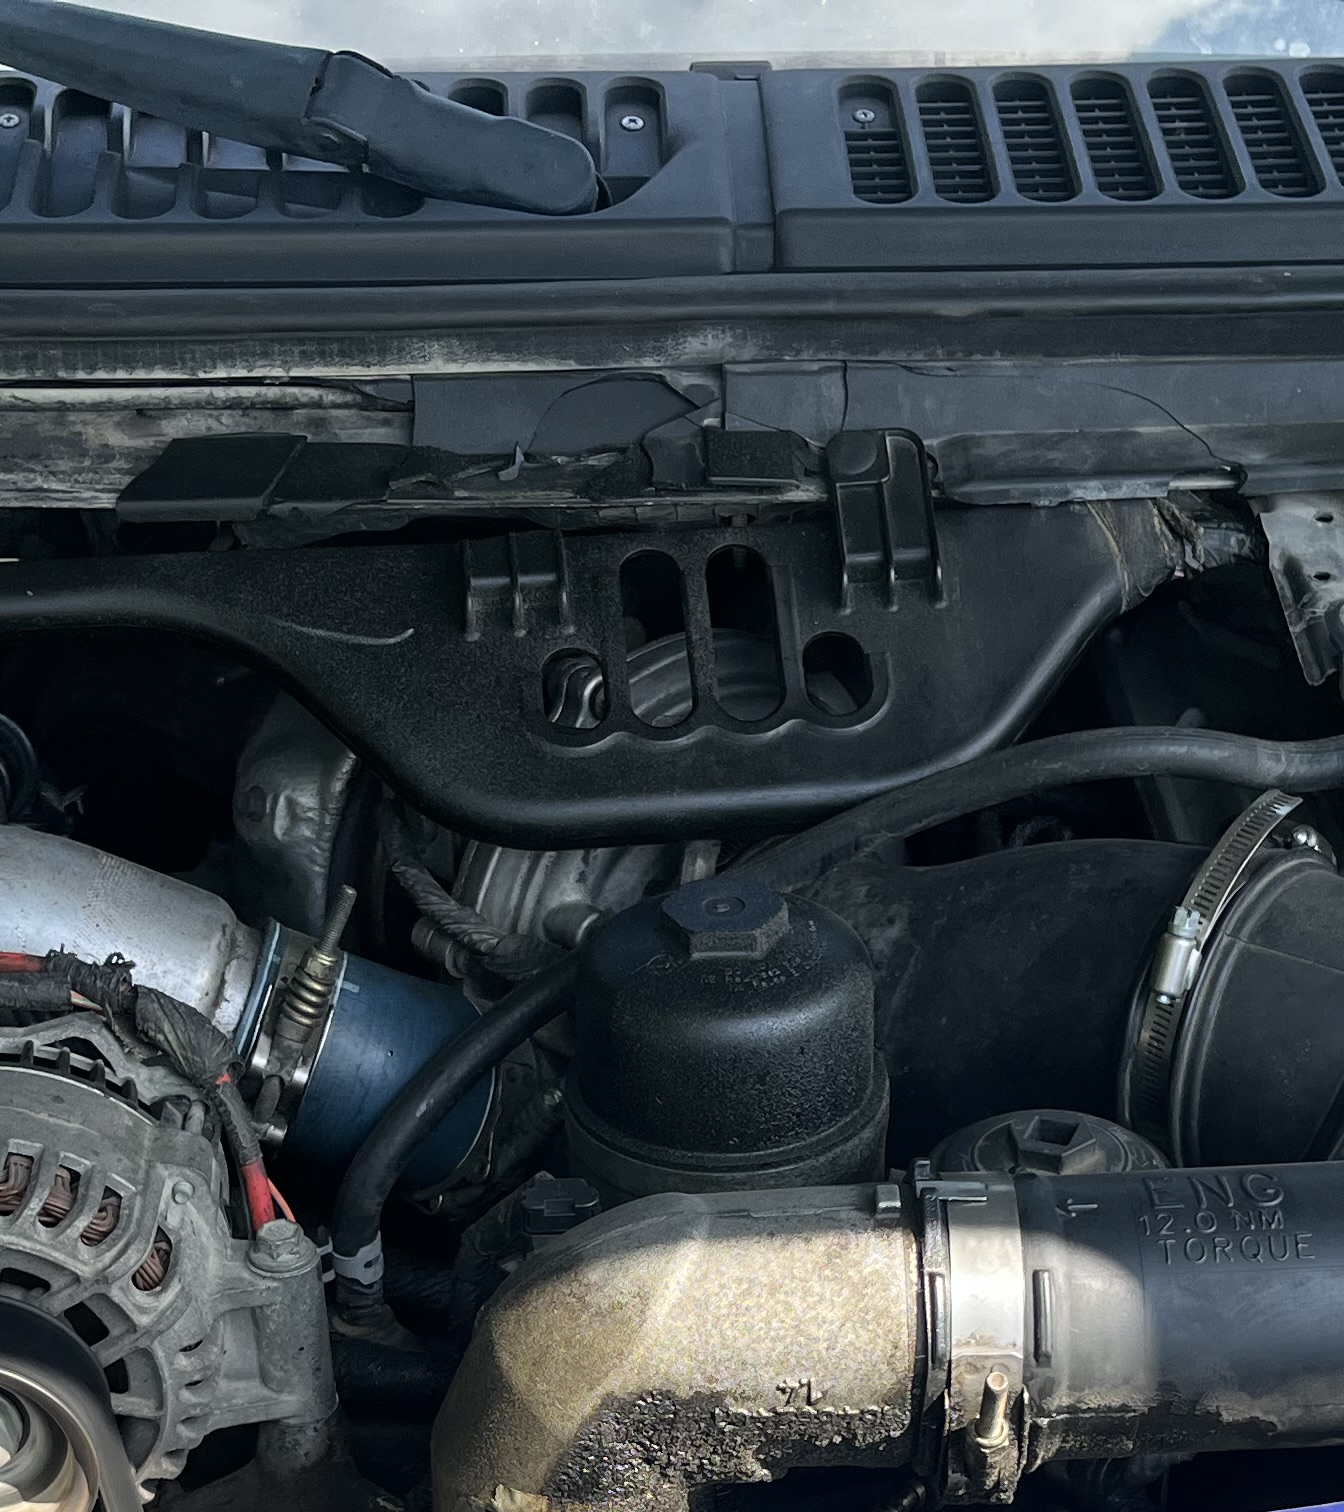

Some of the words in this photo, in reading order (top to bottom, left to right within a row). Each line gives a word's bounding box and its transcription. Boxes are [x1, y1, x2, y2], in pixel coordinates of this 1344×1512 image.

[1143, 1172, 1285, 1209] ENG
[1138, 1211, 1217, 1236] 12.0
[1231, 1208, 1285, 1231] NM
[1157, 1232, 1316, 1264] TORQUE
